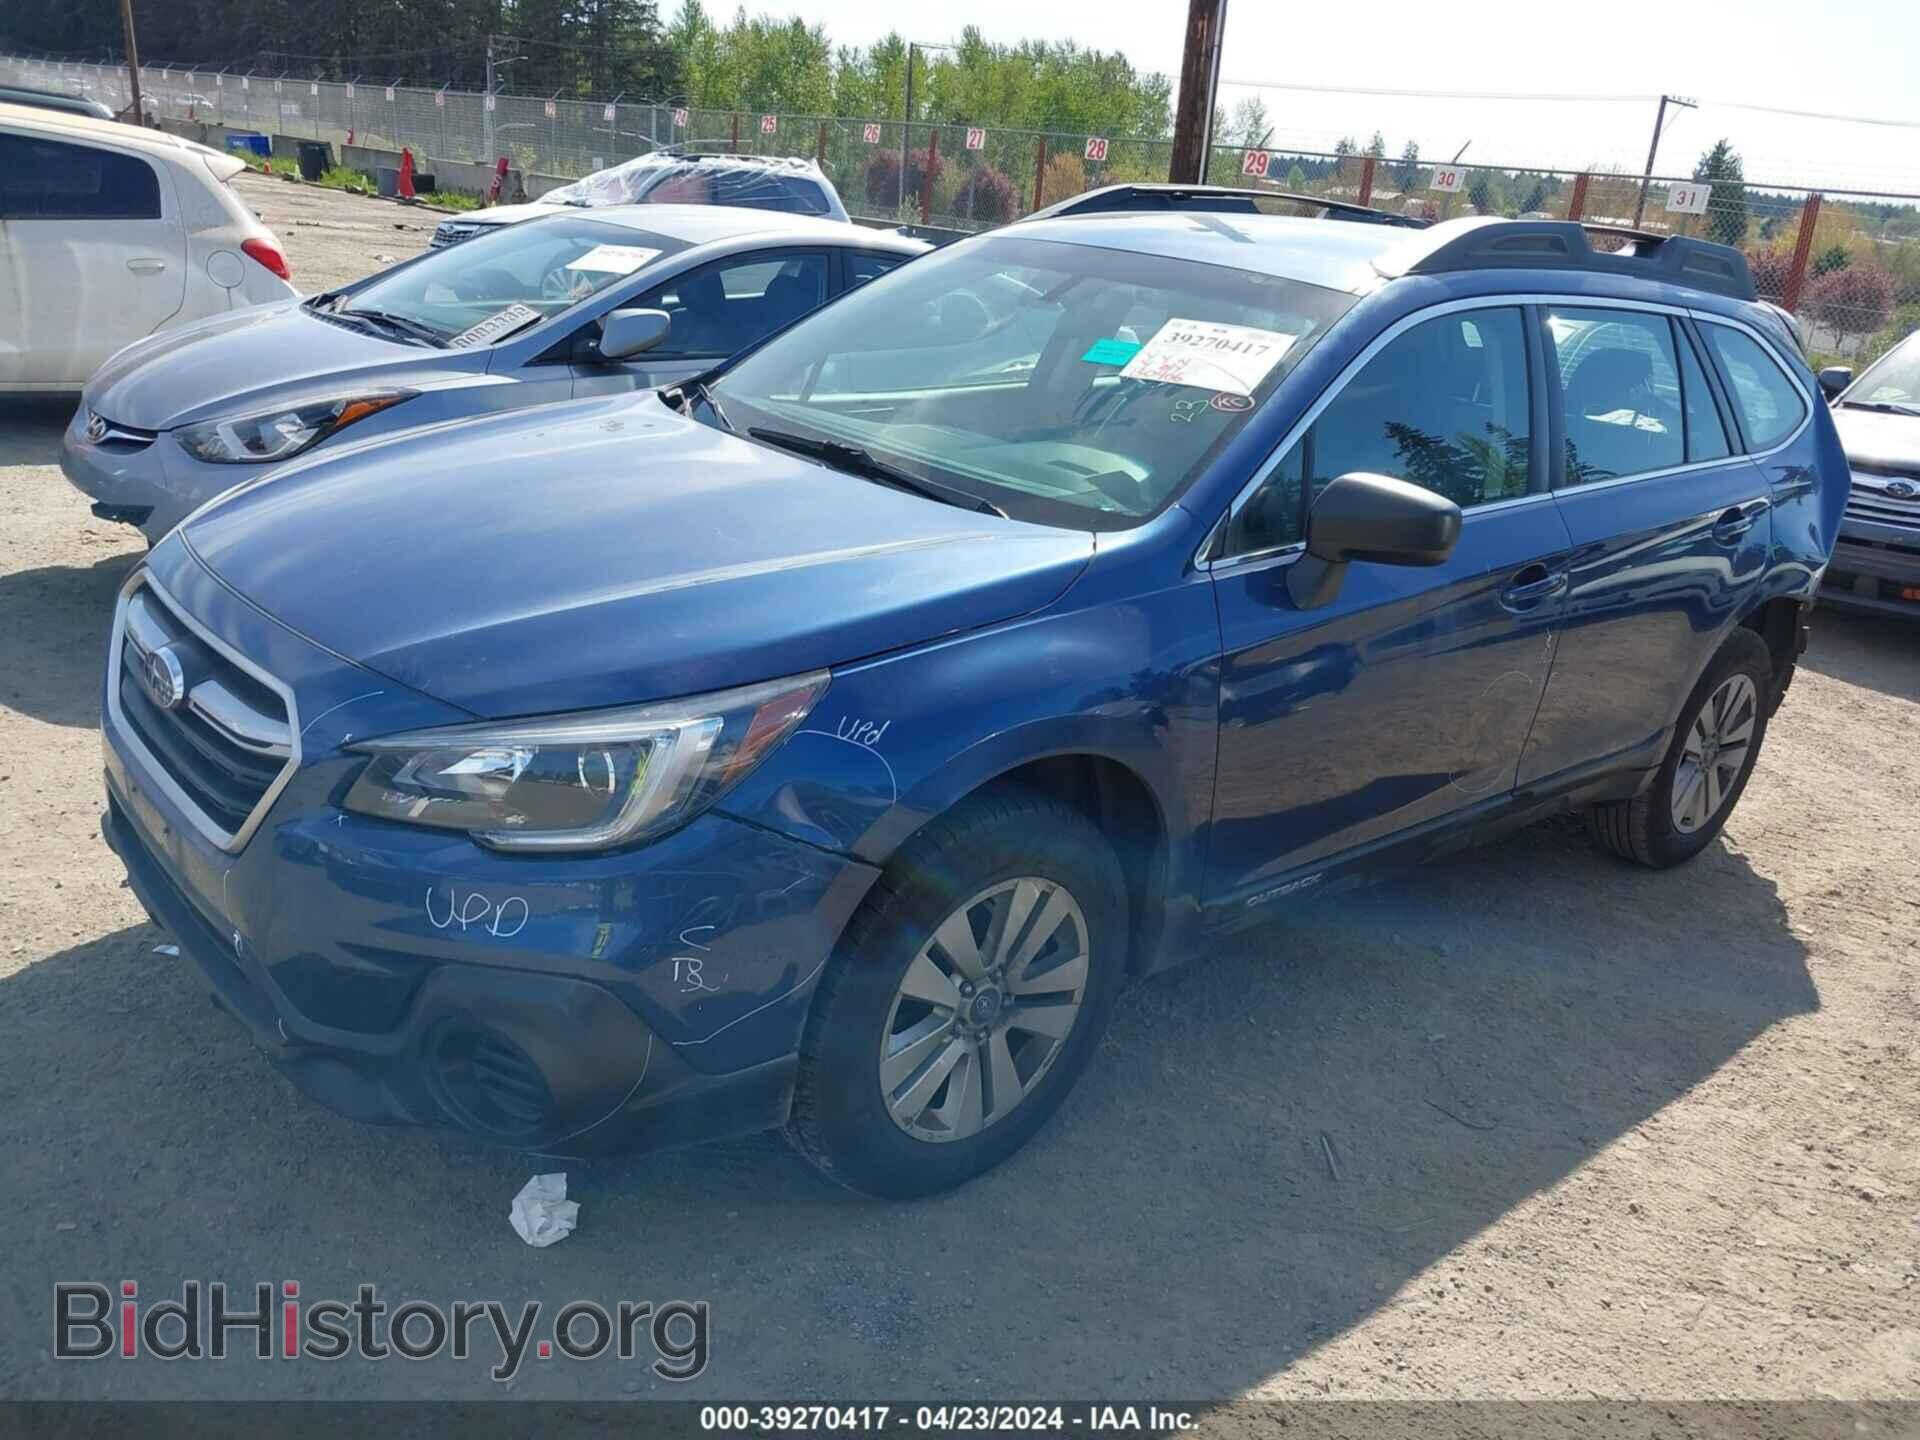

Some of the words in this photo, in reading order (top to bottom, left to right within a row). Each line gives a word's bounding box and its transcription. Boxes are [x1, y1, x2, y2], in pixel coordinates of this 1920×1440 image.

[761, 116, 775, 132] 25
[865, 125, 879, 142] 26
[968, 128, 983, 148] 27
[1087, 139, 1106, 159] 28
[1245, 151, 1268, 174] 29
[1438, 172, 1455, 186] 30
[1676, 191, 1696, 206] 31
[1164, 332, 1270, 356] 39270417
